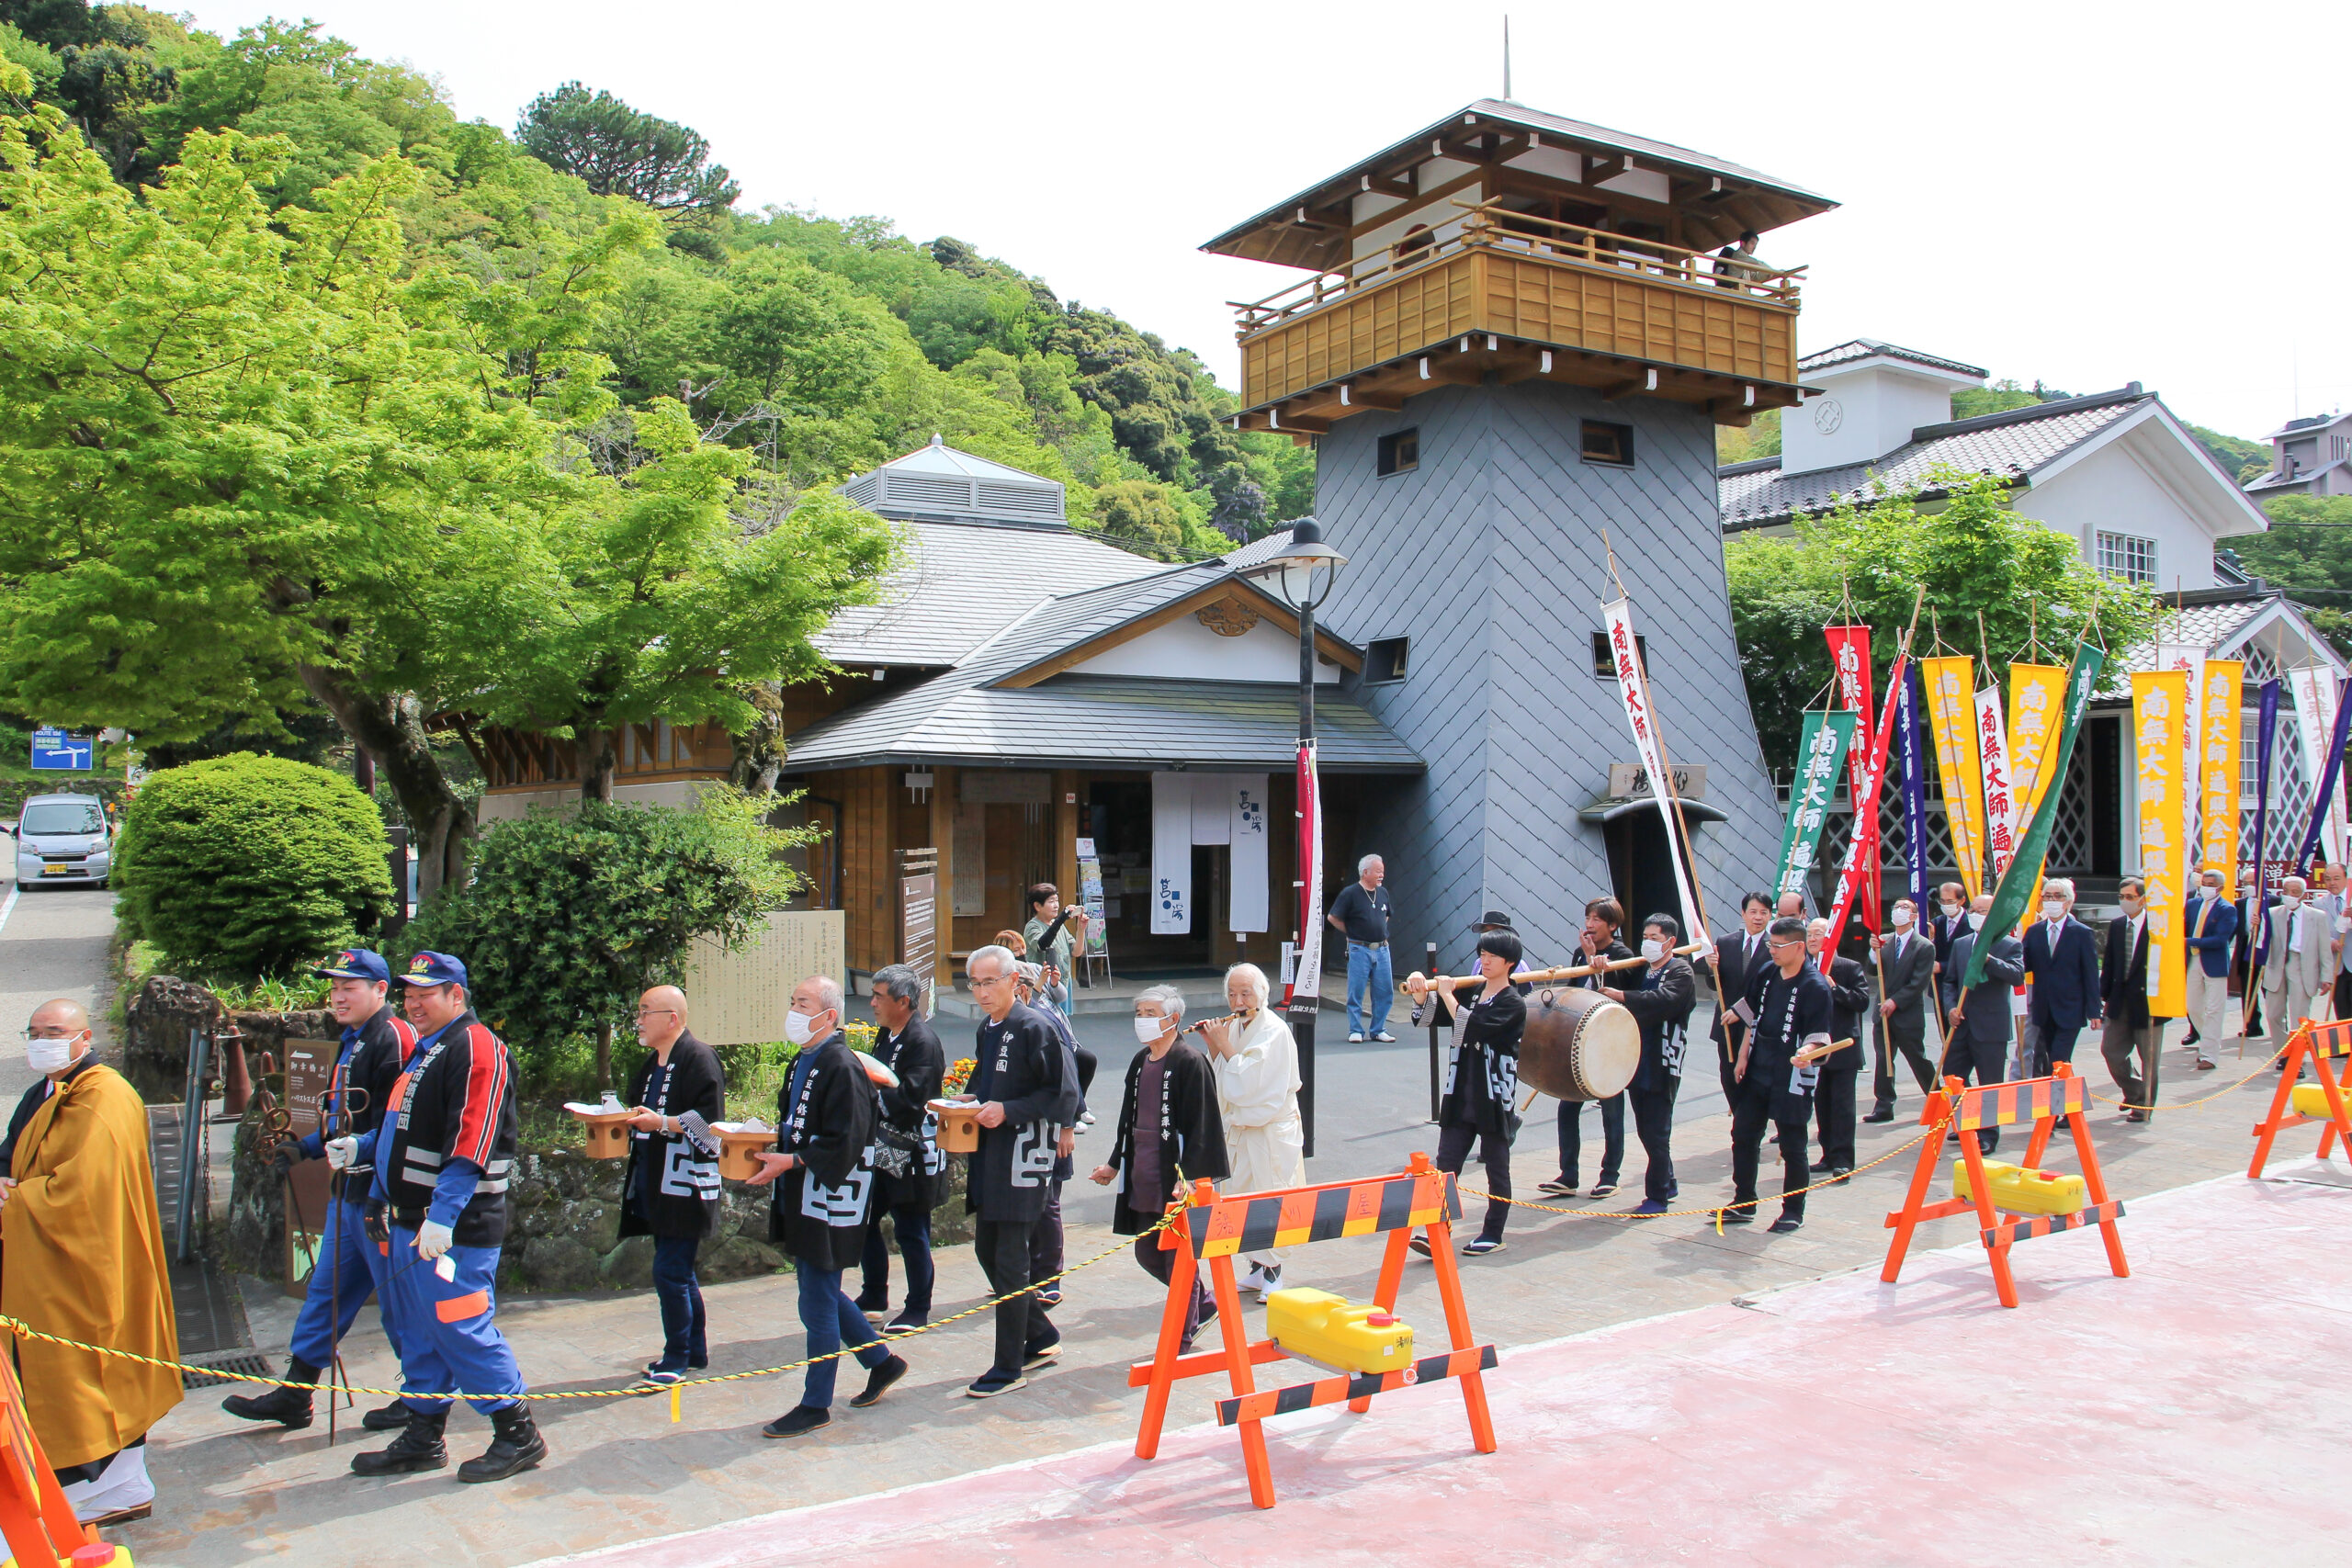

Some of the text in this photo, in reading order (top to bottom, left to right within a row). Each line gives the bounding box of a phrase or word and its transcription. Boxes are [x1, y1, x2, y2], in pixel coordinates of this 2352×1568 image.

[1771, 725, 1838, 919] 南無大師遍照
[2138, 686, 2174, 938] 南無大師遍照金剛
[2206, 671, 2233, 864] 南無大師遍照金剛
